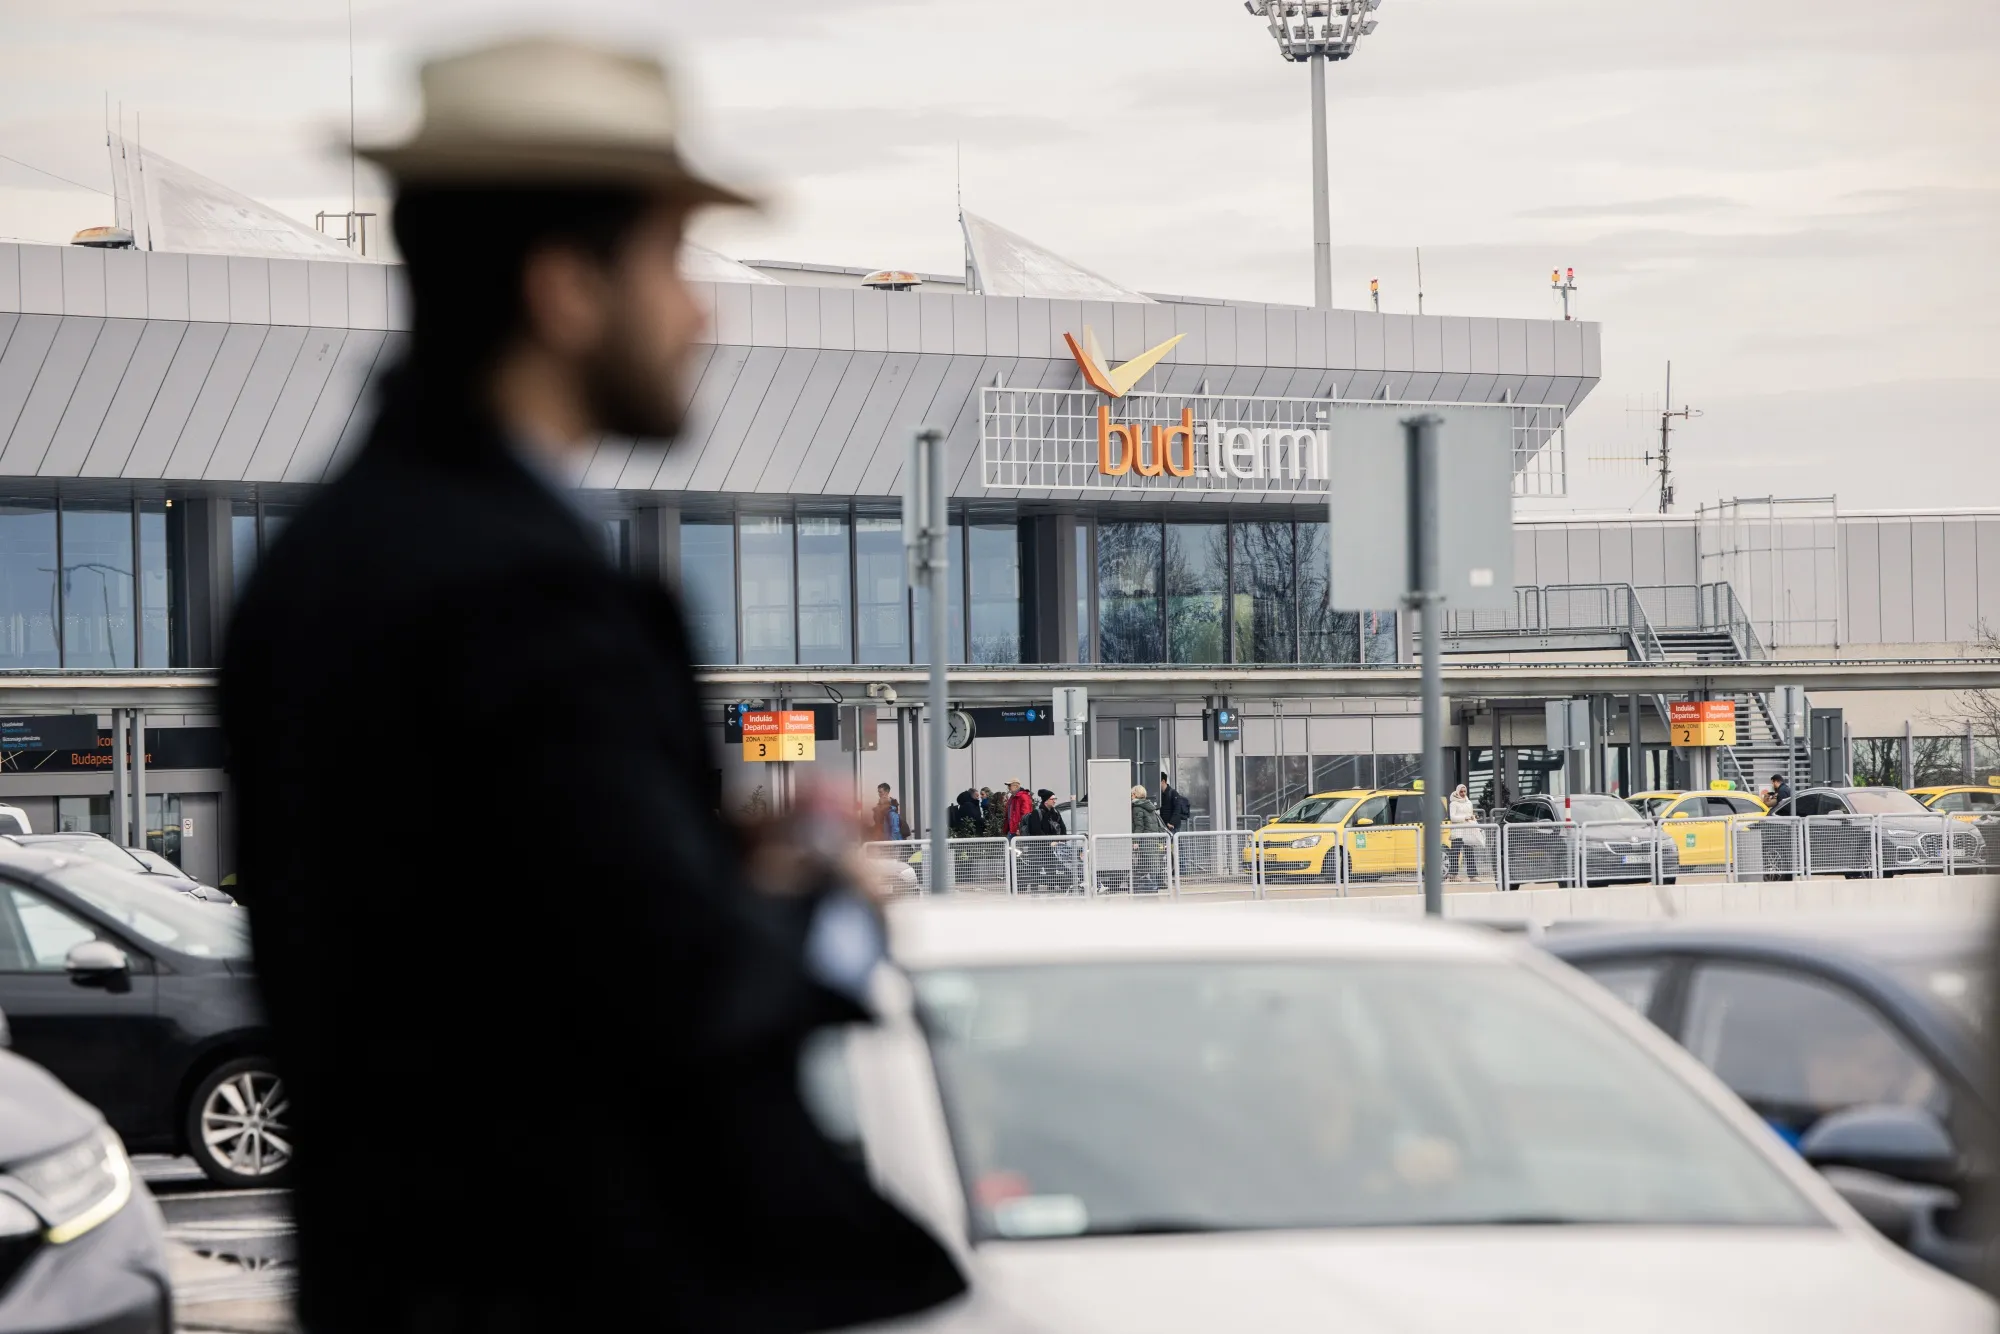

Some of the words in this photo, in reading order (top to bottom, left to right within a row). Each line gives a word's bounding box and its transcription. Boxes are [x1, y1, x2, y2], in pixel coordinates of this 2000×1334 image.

[1098, 405, 1330, 480] bud:termi
[749, 714, 773, 722] Indulás
[744, 723, 778, 731] Departures
[1684, 730, 1690, 742] 2
[1719, 729, 1725, 741] 2
[758, 743, 766, 756] 3
[798, 743, 804, 756] 3
[71, 752, 113, 768] Budapes
